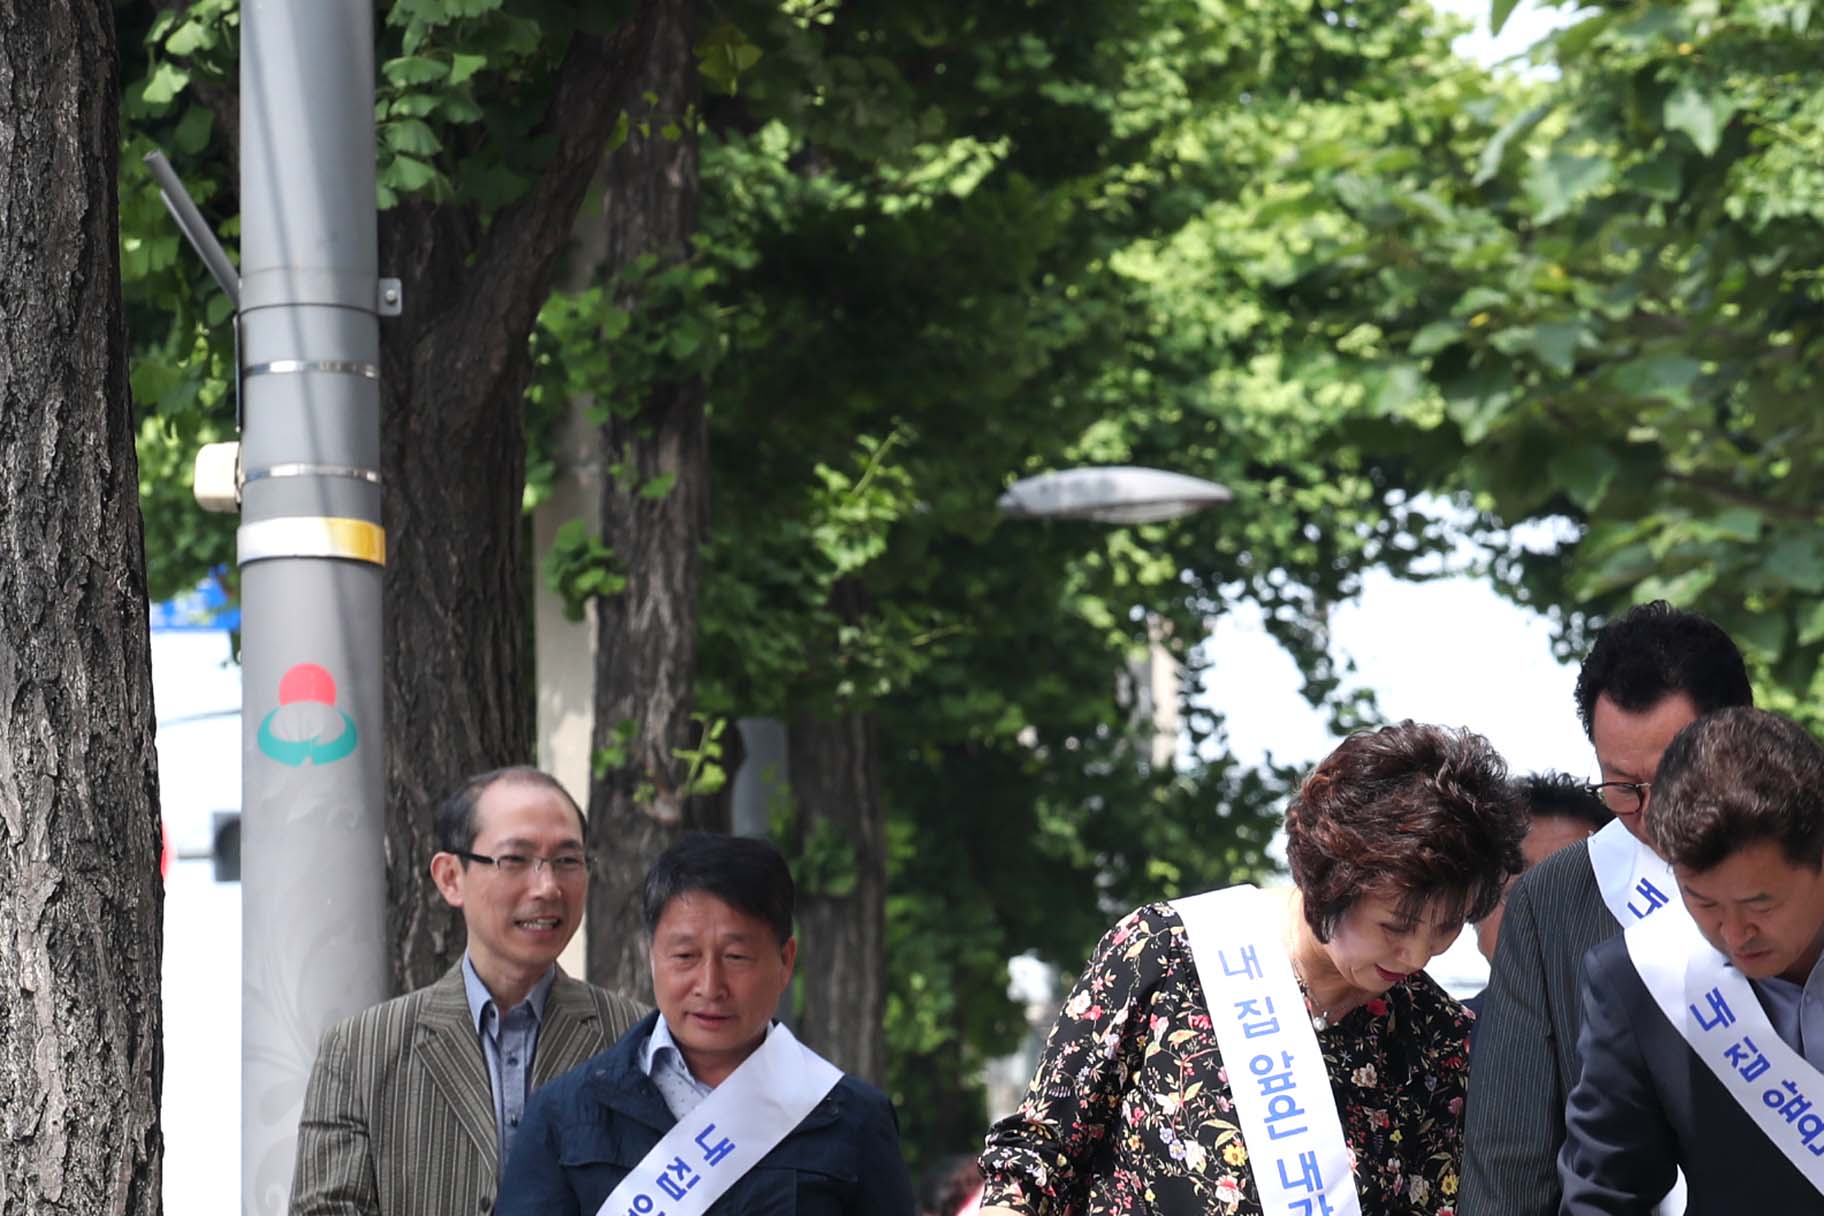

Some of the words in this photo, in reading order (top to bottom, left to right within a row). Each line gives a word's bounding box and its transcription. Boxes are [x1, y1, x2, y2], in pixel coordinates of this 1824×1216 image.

[1627, 878, 1669, 920] 내
[1218, 944, 1264, 981] 내
[1235, 995, 1280, 1040] 집
[1689, 985, 1737, 1032] 내
[1723, 1036, 1772, 1083] 집
[1249, 1050, 1308, 1141] 앞은
[694, 1122, 737, 1168] 내
[655, 1155, 702, 1202] 집
